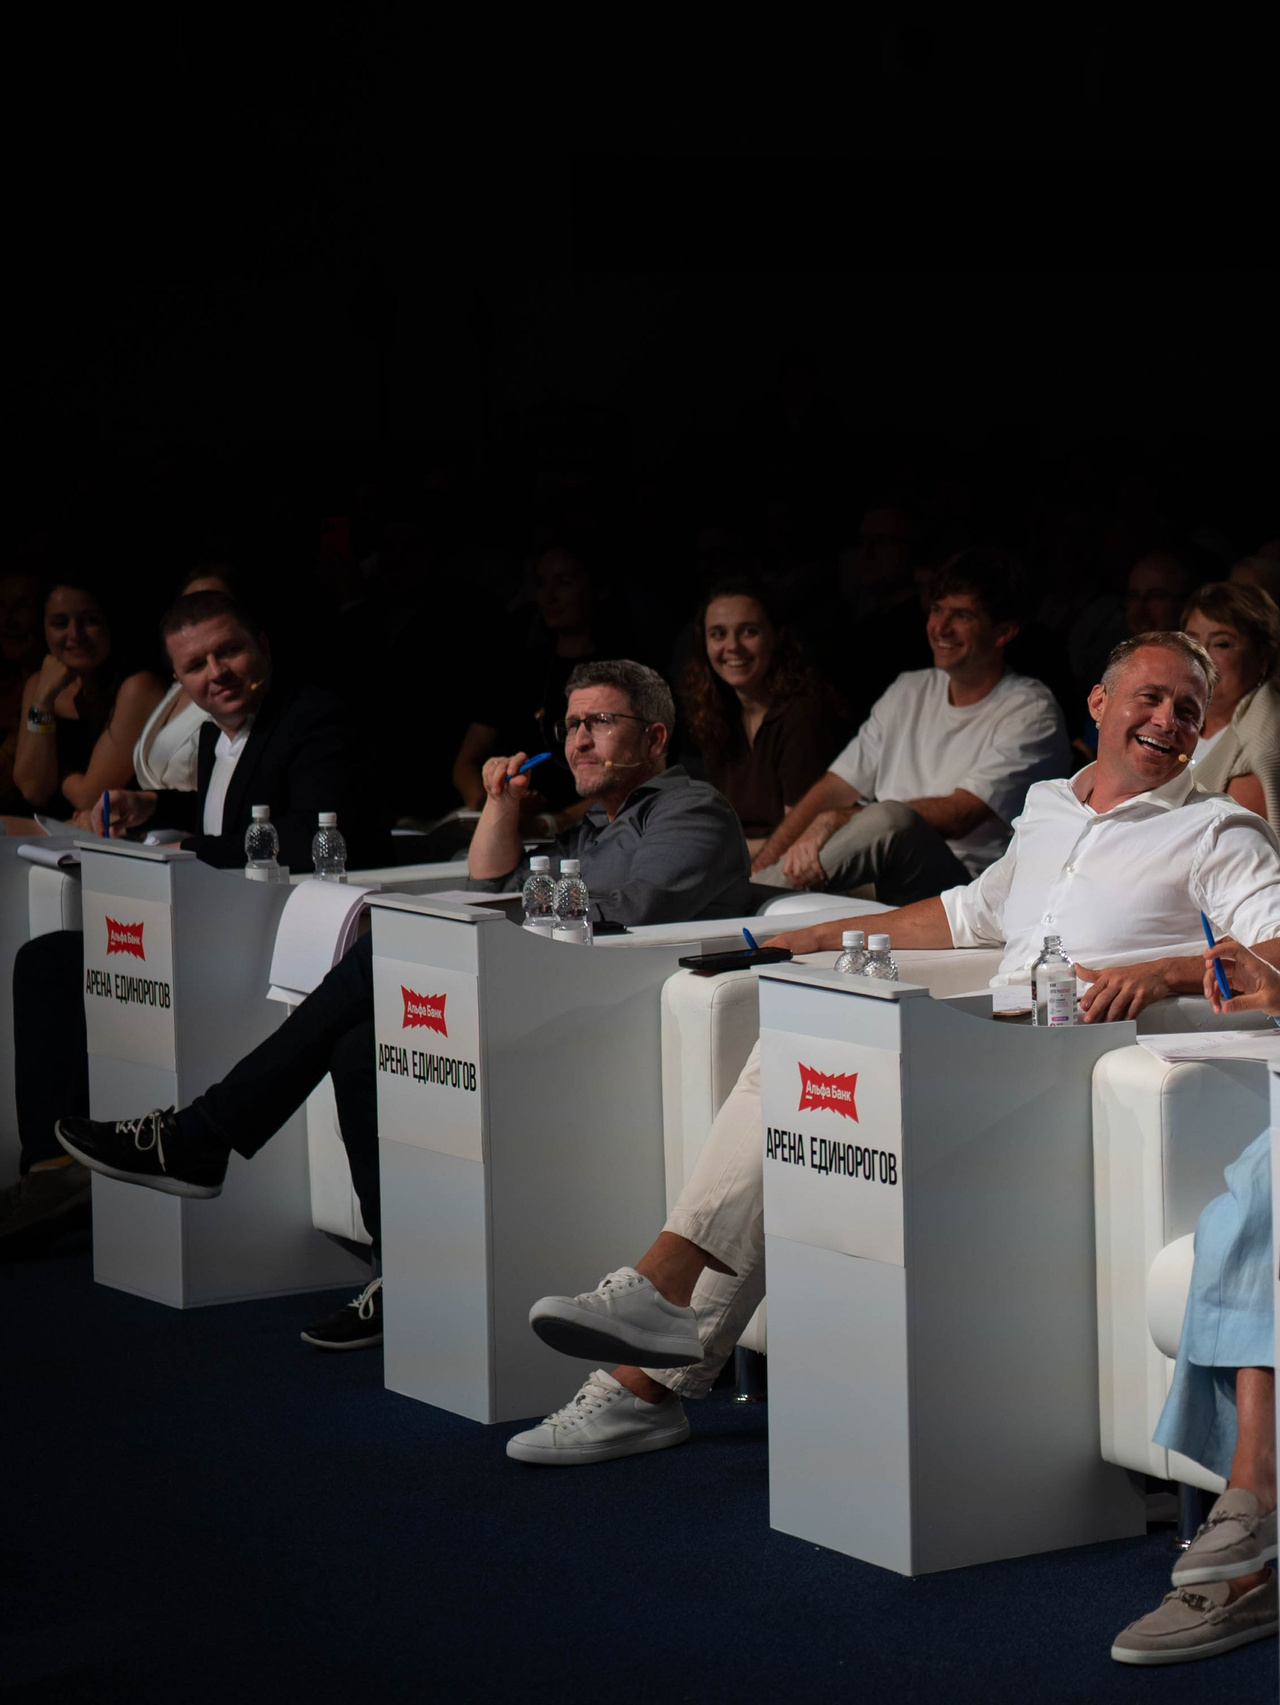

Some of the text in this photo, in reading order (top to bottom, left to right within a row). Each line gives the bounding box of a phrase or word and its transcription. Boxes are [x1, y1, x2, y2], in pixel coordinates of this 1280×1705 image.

[127, 932, 141, 946] Банк
[86, 968, 171, 1009] АРЕНА ЕДИНОРОГОВ
[407, 1000, 442, 1019] Альфа Банк
[378, 1043, 477, 1092] АРЕНА ЕДИНОРОГОВ
[805, 1079, 852, 1102] Альфа Банк
[766, 1127, 898, 1186] АРЕНА ЕДИНОРОГОВ
